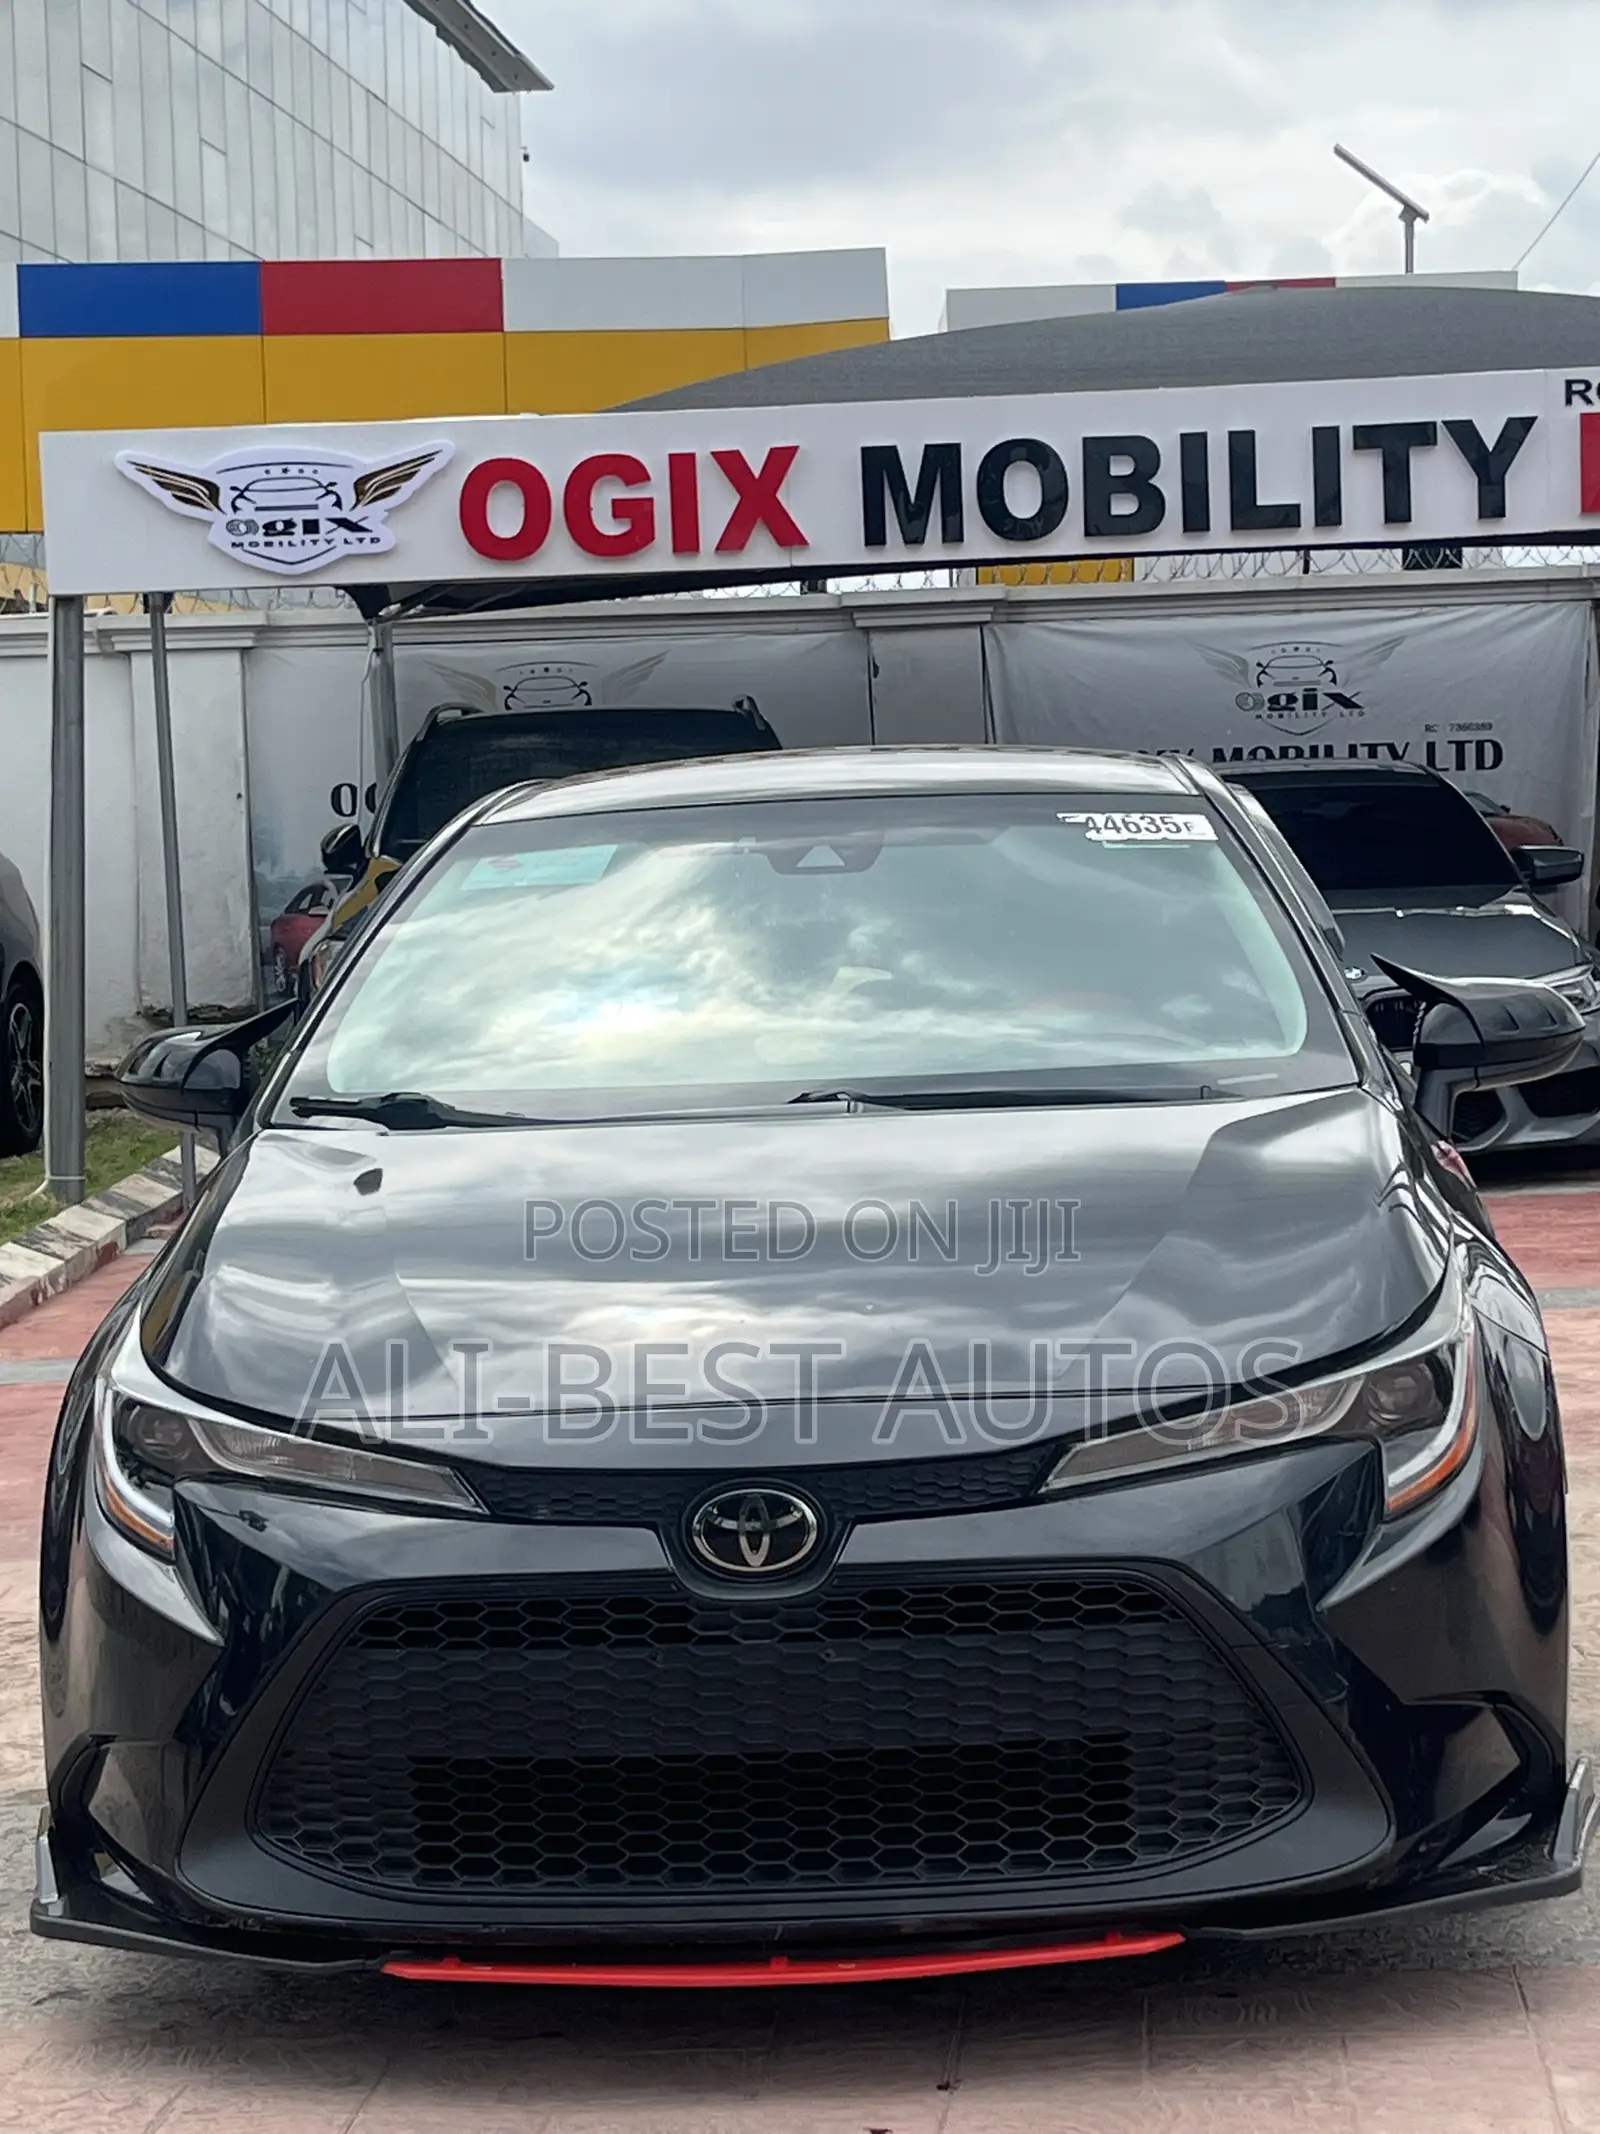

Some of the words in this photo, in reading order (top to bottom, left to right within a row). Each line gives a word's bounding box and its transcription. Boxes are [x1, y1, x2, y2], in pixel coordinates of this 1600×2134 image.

[1564, 378, 1600, 407] R
[459, 445, 808, 562] OGIX
[860, 416, 1538, 547] MOBILITY
[231, 538, 335, 548] MOBILITY
[343, 536, 381, 545] LTD
[1425, 738, 1504, 772] LTD
